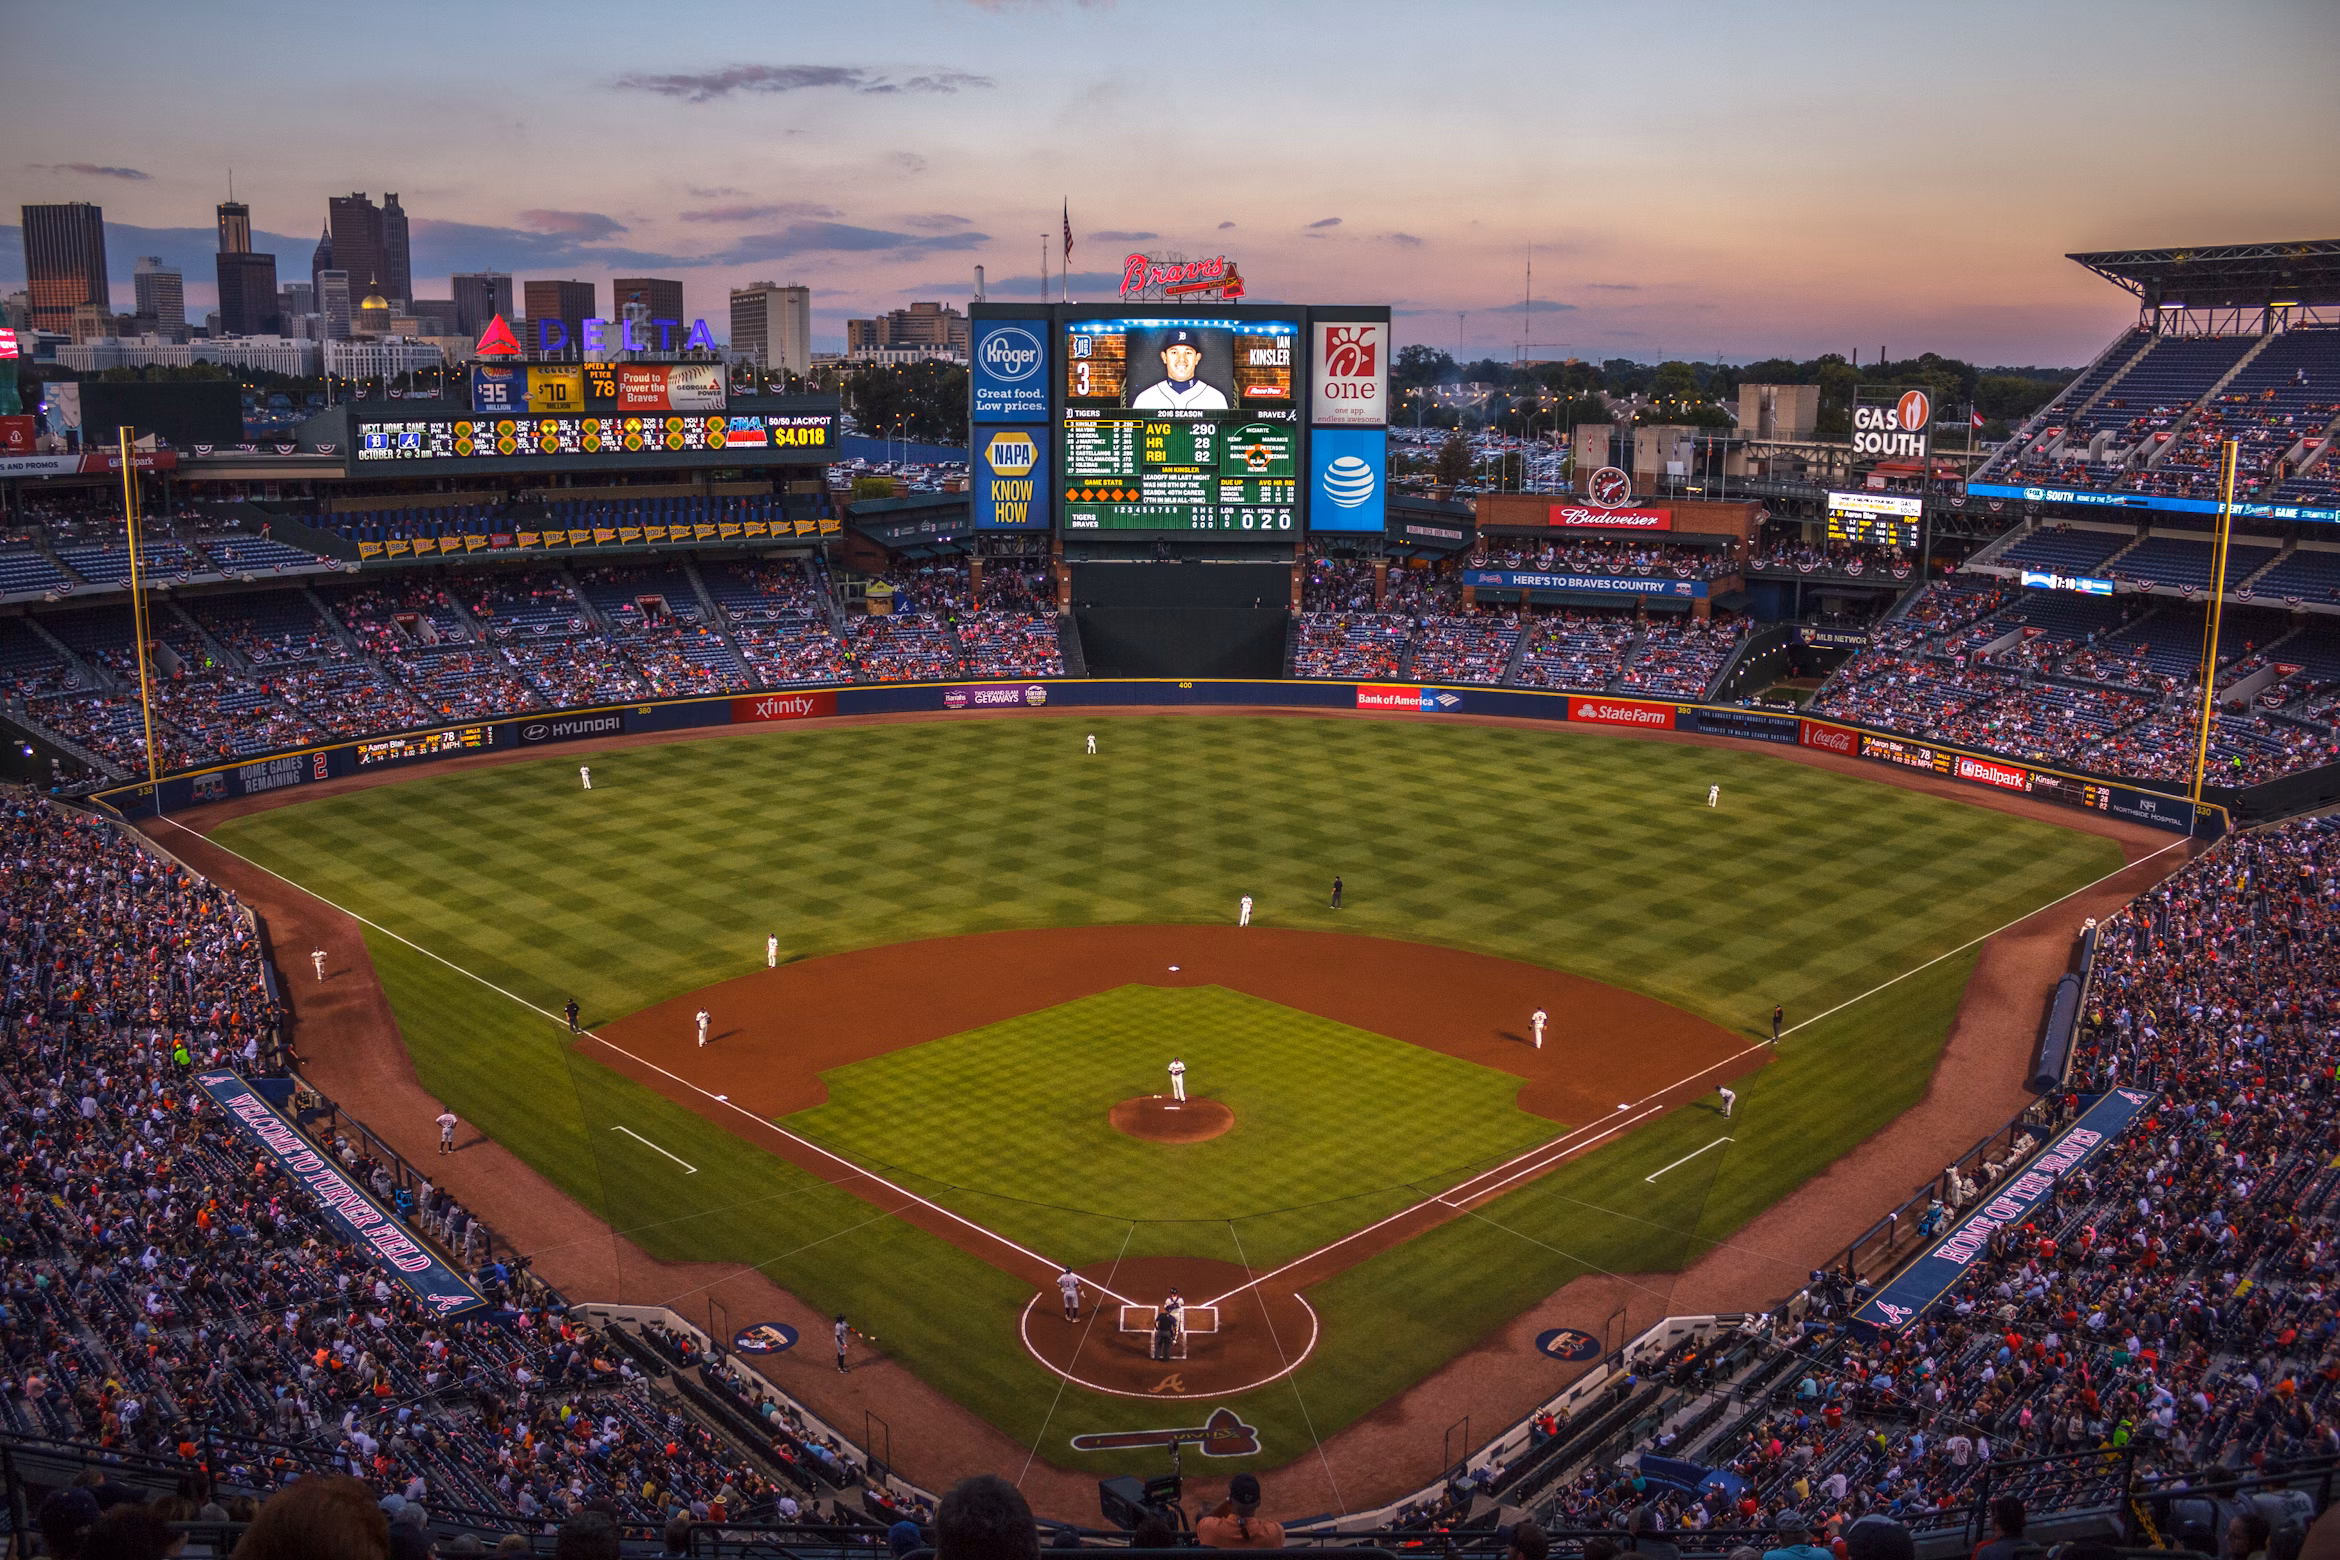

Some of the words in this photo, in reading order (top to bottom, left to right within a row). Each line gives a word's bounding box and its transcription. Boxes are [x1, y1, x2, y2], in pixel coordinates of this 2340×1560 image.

[1120, 253, 1224, 297] Braves
[540, 318, 717, 351] DELTA
[1277, 336, 1290, 348] IAN
[987, 338, 1036, 374] Kroger
[1250, 348, 1290, 366] KINSLER
[624, 373, 652, 383] Proud
[652, 374, 662, 382] to
[1077, 362, 1090, 395] 3
[593, 380, 616, 398] 78
[621, 383, 648, 393] Power
[649, 383, 667, 393] the
[977, 388, 1012, 398] Great
[1014, 388, 1045, 398] food.
[1324, 382, 1375, 399] one
[628, 393, 660, 402] Braves
[546, 402, 571, 410] MILLION
[976, 400, 1002, 410] Low
[1004, 400, 1046, 413] prices.
[1350, 408, 1366, 416] app.
[769, 416, 790, 425] 50/50
[791, 416, 832, 424] JACKPOT
[1854, 408, 1898, 430] GAS
[362, 423, 381, 434] NEXT
[383, 422, 404, 433] HOME
[407, 422, 427, 432] GAME
[1146, 424, 1171, 434] AVG
[1190, 424, 1216, 434] .290
[775, 428, 826, 446] $4,018
[1146, 437, 1164, 448] HR
[1194, 438, 1210, 448] 28
[1852, 432, 1926, 457] SOUTH
[358, 449, 394, 460] OCTOBER
[396, 449, 402, 459] 2
[414, 448, 420, 458] 3
[994, 444, 1030, 465] NAPA
[1146, 450, 1166, 462] RBI
[1194, 451, 1210, 462] 82
[7, 462, 25, 470] AND
[26, 461, 58, 470] PROMOS
[991, 480, 1034, 502] KNOW
[2046, 490, 2074, 501] SOUTH
[995, 502, 1028, 523] HOW
[1560, 509, 1658, 527] Budweiser
[1862, 512, 1878, 520] Blair
[2274, 508, 2298, 518] GAME
[1242, 514, 1254, 529] 0
[1260, 514, 1272, 528] 2
[1279, 514, 1290, 529] 0
[1904, 516, 1918, 524] RHP
[361, 545, 378, 554] 1969
[388, 543, 404, 551] 1982
[1513, 575, 1551, 586] HERE'S
[1552, 576, 1564, 586] TO
[1568, 577, 1611, 589] BRAVES
[1612, 579, 1665, 591] COUNTRY
[1816, 633, 1833, 642] MLB
[1834, 634, 1868, 645] NETWOR
[974, 694, 1020, 704] GETAWAYS
[1358, 694, 1382, 704] Bank
[1384, 695, 1394, 704] of
[1394, 696, 1434, 707] America
[638, 706, 651, 714] 380
[756, 696, 812, 719] xfinity
[1677, 707, 1692, 715] 390
[553, 717, 620, 736] HYUNDAI
[426, 734, 440, 743] RHP
[442, 732, 455, 742] 78
[358, 746, 367, 754] 36
[368, 742, 389, 752] Aaron
[390, 740, 406, 750] Blair
[442, 741, 460, 750] MPH
[1870, 739, 1889, 748] Aaron
[1889, 742, 1904, 752] Blair
[1920, 748, 1931, 760] 78
[240, 762, 267, 780] HOME
[270, 756, 303, 774] GAMES
[314, 752, 328, 780] 2
[1917, 759, 1934, 769] MPH
[245, 770, 303, 794] REMAINING
[1974, 764, 2024, 788] Ballpark
[2035, 774, 2060, 786] Kinsler
[138, 786, 154, 797] 335
[2113, 804, 2150, 819] NORTHSIDE
[2150, 811, 2183, 826] HOSPITAL
[2195, 806, 2212, 817] 330
[224, 1092, 308, 1156] WELCOME
[285, 1149, 324, 1172] TO
[304, 1168, 383, 1230] TURNER
[1933, 1214, 1997, 1265] HOME
[1984, 1194, 2025, 1221] OF
[2008, 1169, 2056, 1201] THE
[2033, 1127, 2102, 1178] BRAVES
[362, 1222, 431, 1272] FIELD
